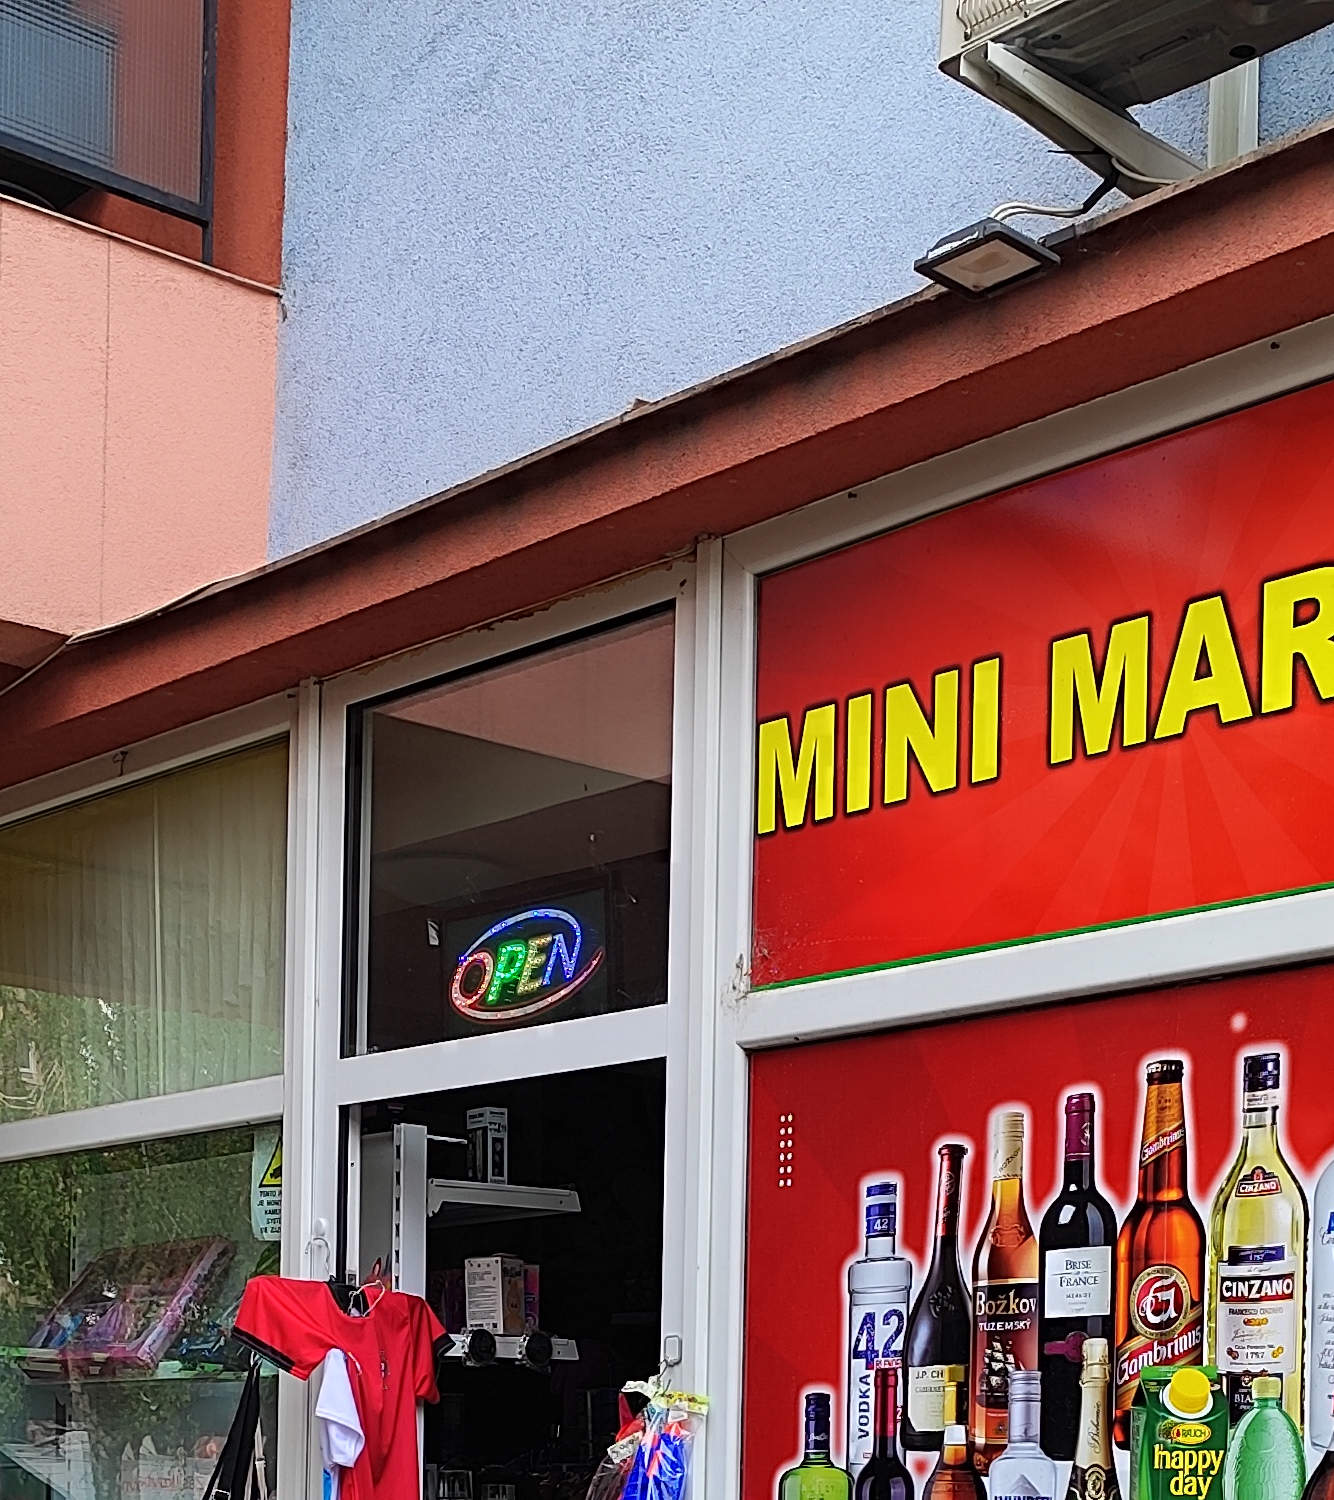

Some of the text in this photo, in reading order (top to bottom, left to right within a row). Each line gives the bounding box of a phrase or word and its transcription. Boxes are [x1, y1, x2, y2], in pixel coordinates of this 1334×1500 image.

[757, 658, 1001, 835] MINI
[450, 934, 582, 1008] OPEN
[1141, 1126, 1185, 1161] Gambrinus
[1240, 1181, 1276, 1192] CINZANO
[874, 1219, 888, 1231] 42
[1065, 1260, 1091, 1270] BRISE
[1059, 1276, 1099, 1287] FRANCE
[1222, 1279, 1293, 1299] CINZANO
[978, 1319, 1031, 1331] TUZEMSKÝ
[853, 1309, 904, 1370] 42
[1117, 1324, 1202, 1385] Gambrinus
[931, 1370, 943, 1378] CH
[858, 1374, 871, 1439] VODKA
[1234, 1393, 1251, 1403] BIA
[1182, 1429, 1206, 1438] RAUCH
[1154, 1444, 1225, 1476] happy
[1170, 1472, 1213, 1500] day
